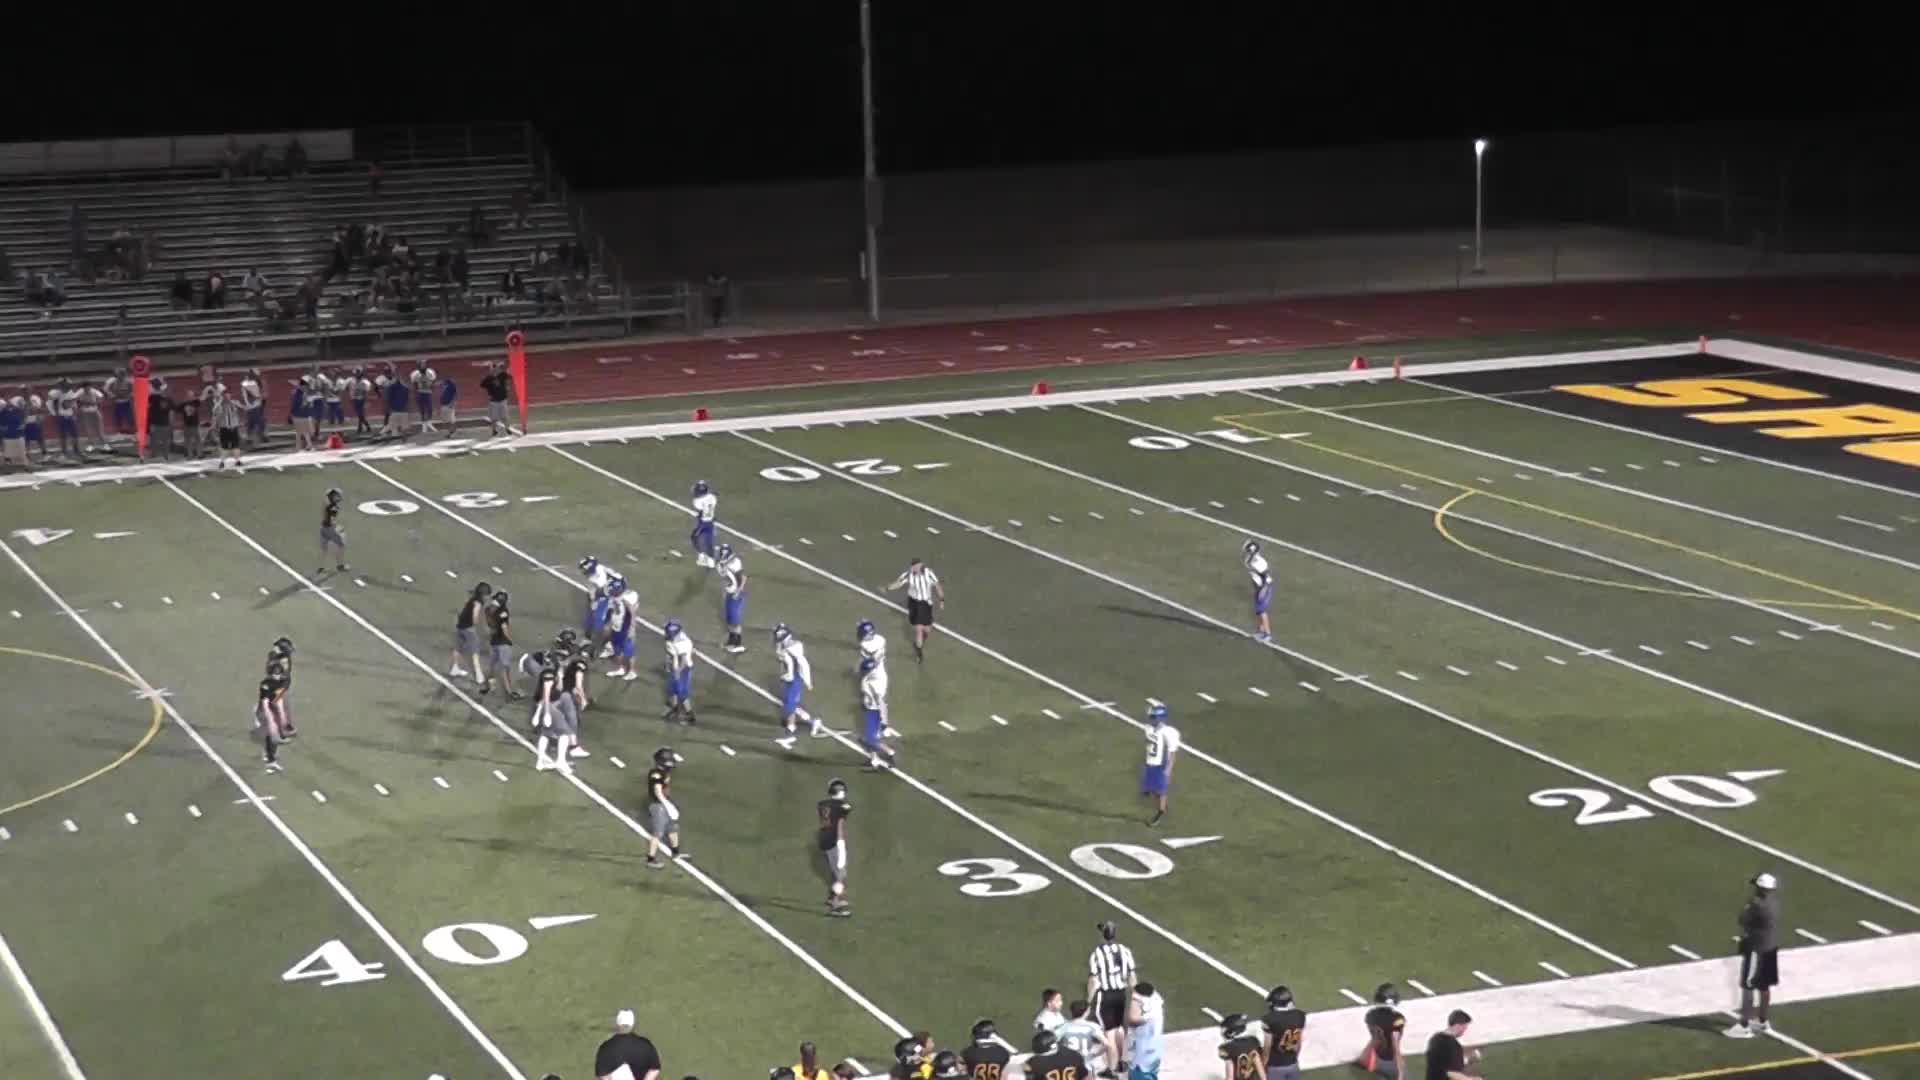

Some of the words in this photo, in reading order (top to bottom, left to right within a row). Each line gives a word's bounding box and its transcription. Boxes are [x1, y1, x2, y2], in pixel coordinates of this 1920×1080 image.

[1550, 378, 1920, 468] SA
[760, 458, 902, 482] 20
[1528, 775, 1757, 825] 20
[937, 843, 1174, 896] 30
[282, 923, 528, 986] 40
